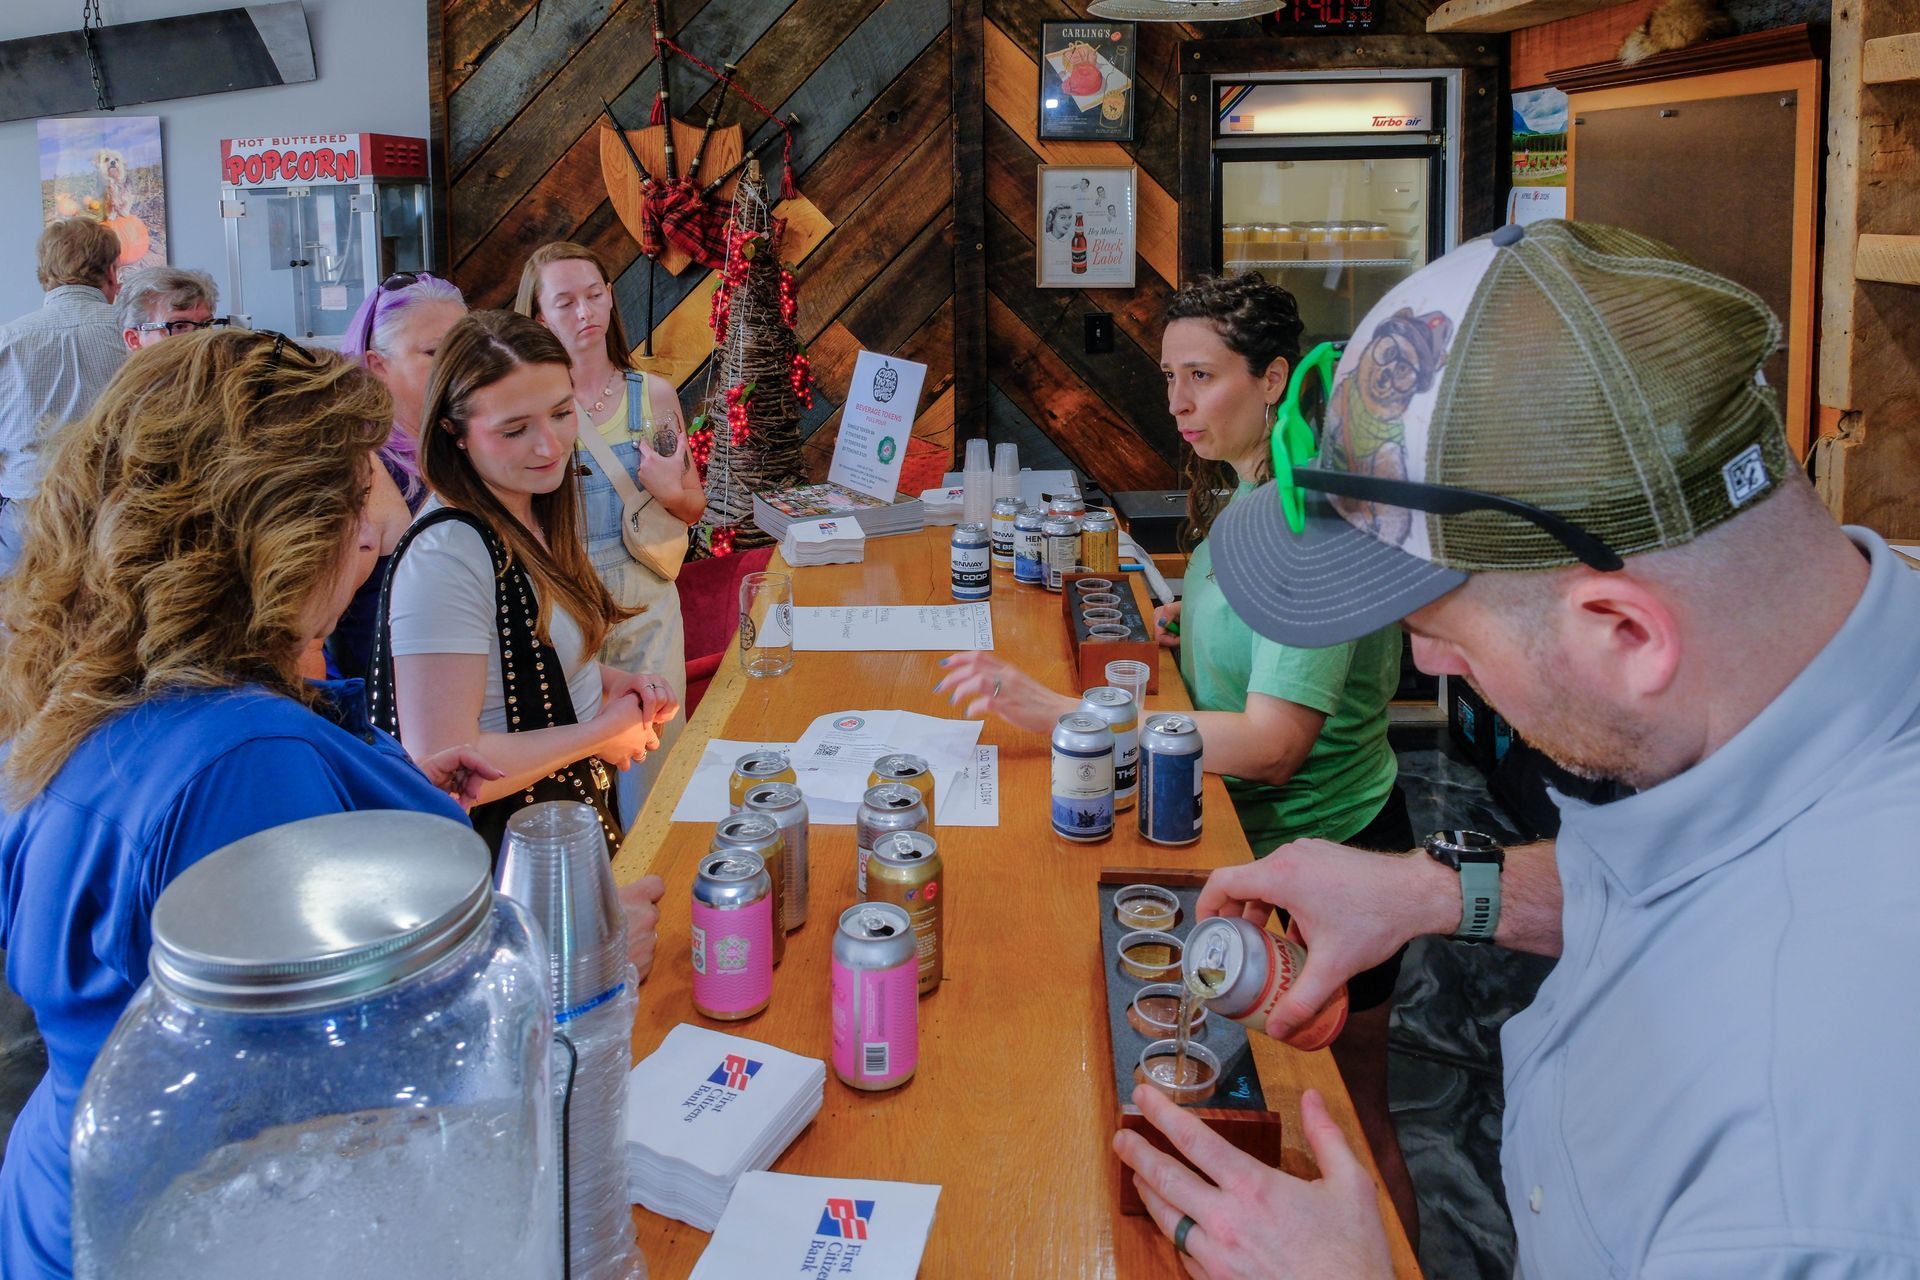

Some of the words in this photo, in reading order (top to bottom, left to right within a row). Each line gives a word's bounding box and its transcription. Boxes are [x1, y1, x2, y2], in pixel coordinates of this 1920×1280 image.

[1062, 28, 1111, 38] CARLING'S
[1372, 116, 1403, 127] Turbo
[1405, 117, 1421, 126] air
[238, 139, 264, 148] HOT
[272, 135, 347, 146] BUTTERED
[225, 148, 359, 186] POPCORN
[1093, 239, 1123, 252] Black
[1092, 251, 1123, 265] Label
[855, 403, 881, 416] BEVERAGE
[881, 410, 902, 423] TOKENS
[962, 573, 988, 581] COOP
[979, 748, 990, 762] OLD
[979, 763, 993, 780] TOWN
[1116, 765, 1137, 780] THE
[979, 781, 993, 806] CIDERY
[681, 1083, 711, 1109] Bank
[711, 1091, 738, 1115] First
[684, 1087, 723, 1124] Citizens
[800, 1240, 826, 1273] Bank
[815, 1241, 843, 1280] Citize
[838, 1244, 862, 1274] First
